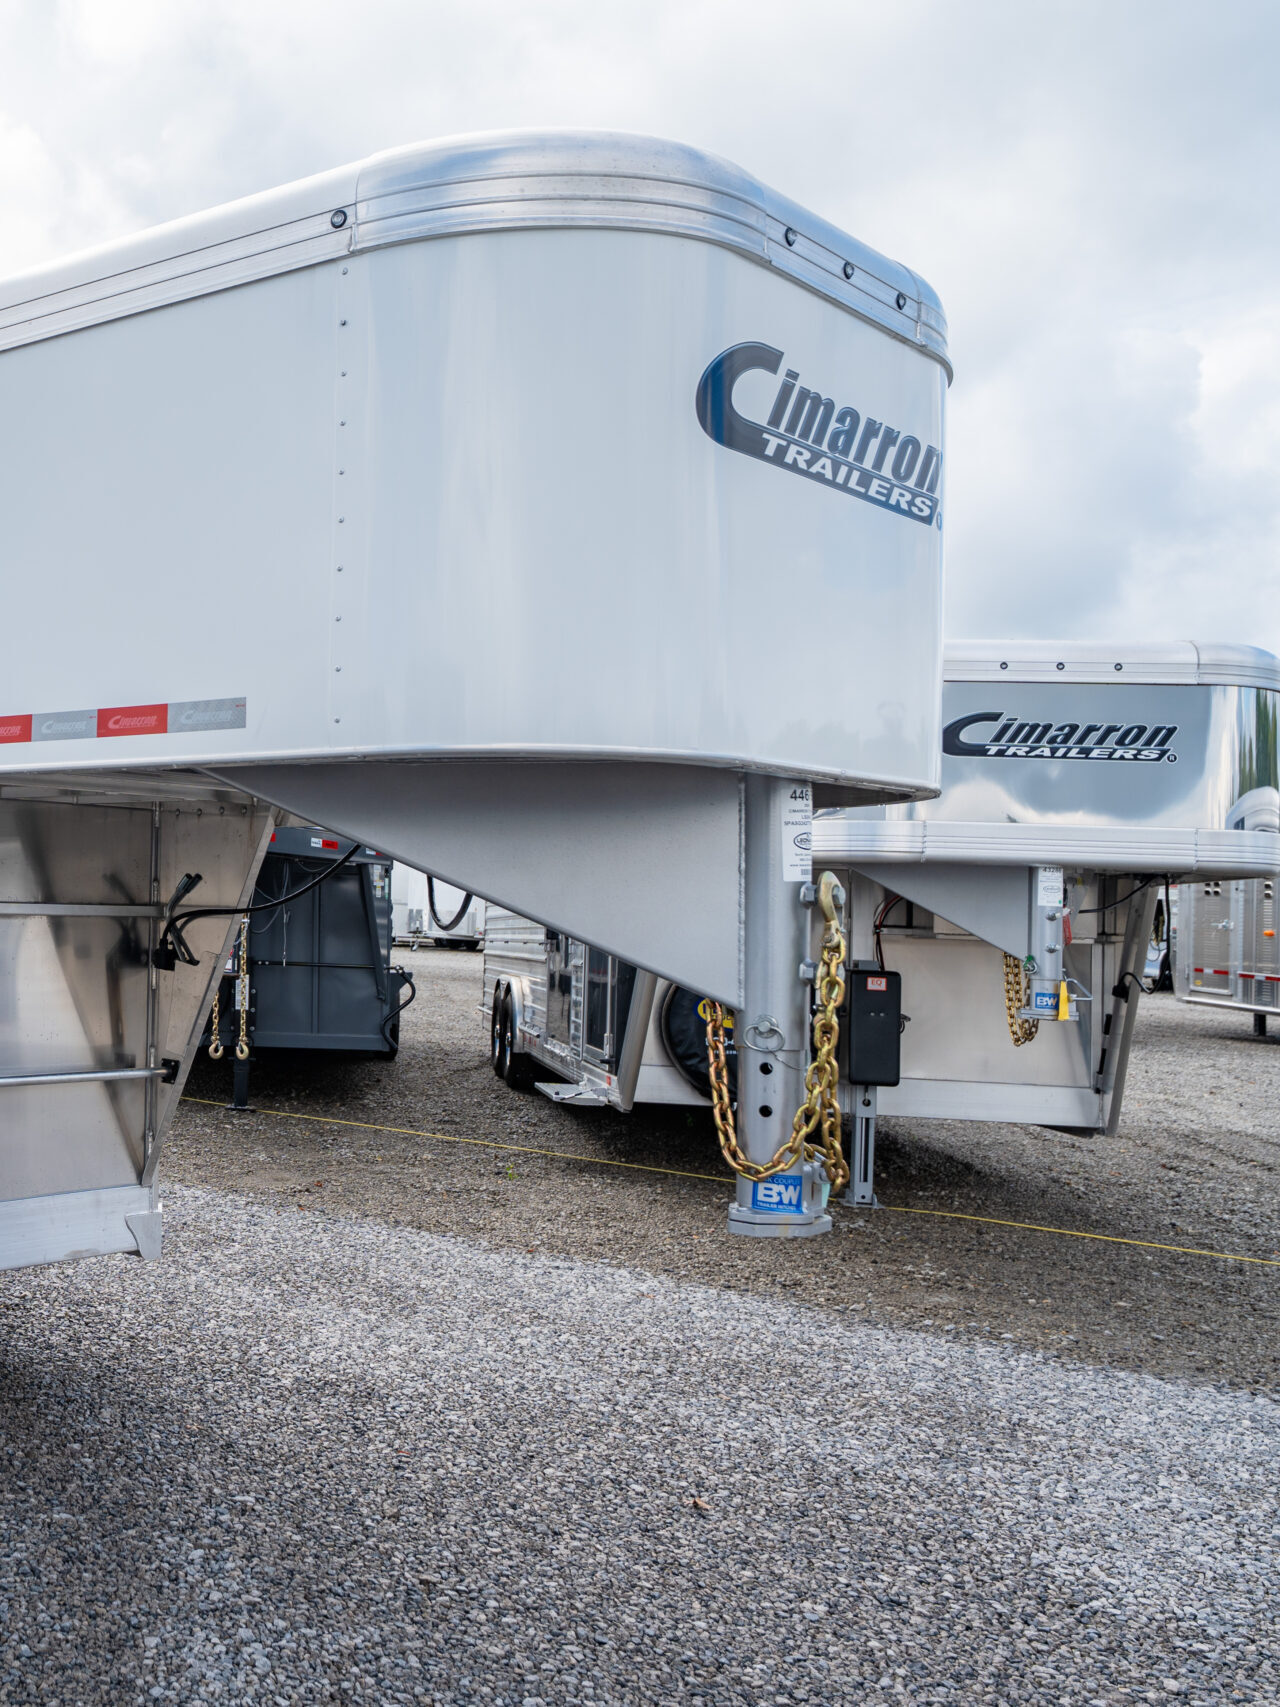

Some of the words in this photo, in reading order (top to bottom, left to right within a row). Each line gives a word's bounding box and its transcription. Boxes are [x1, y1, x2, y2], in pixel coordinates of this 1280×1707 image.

[695, 341, 943, 495] Cimarron
[762, 433, 932, 518] TRAILERS
[942, 711, 1179, 757] Cimarron
[985, 745, 1163, 760] TRAILERS
